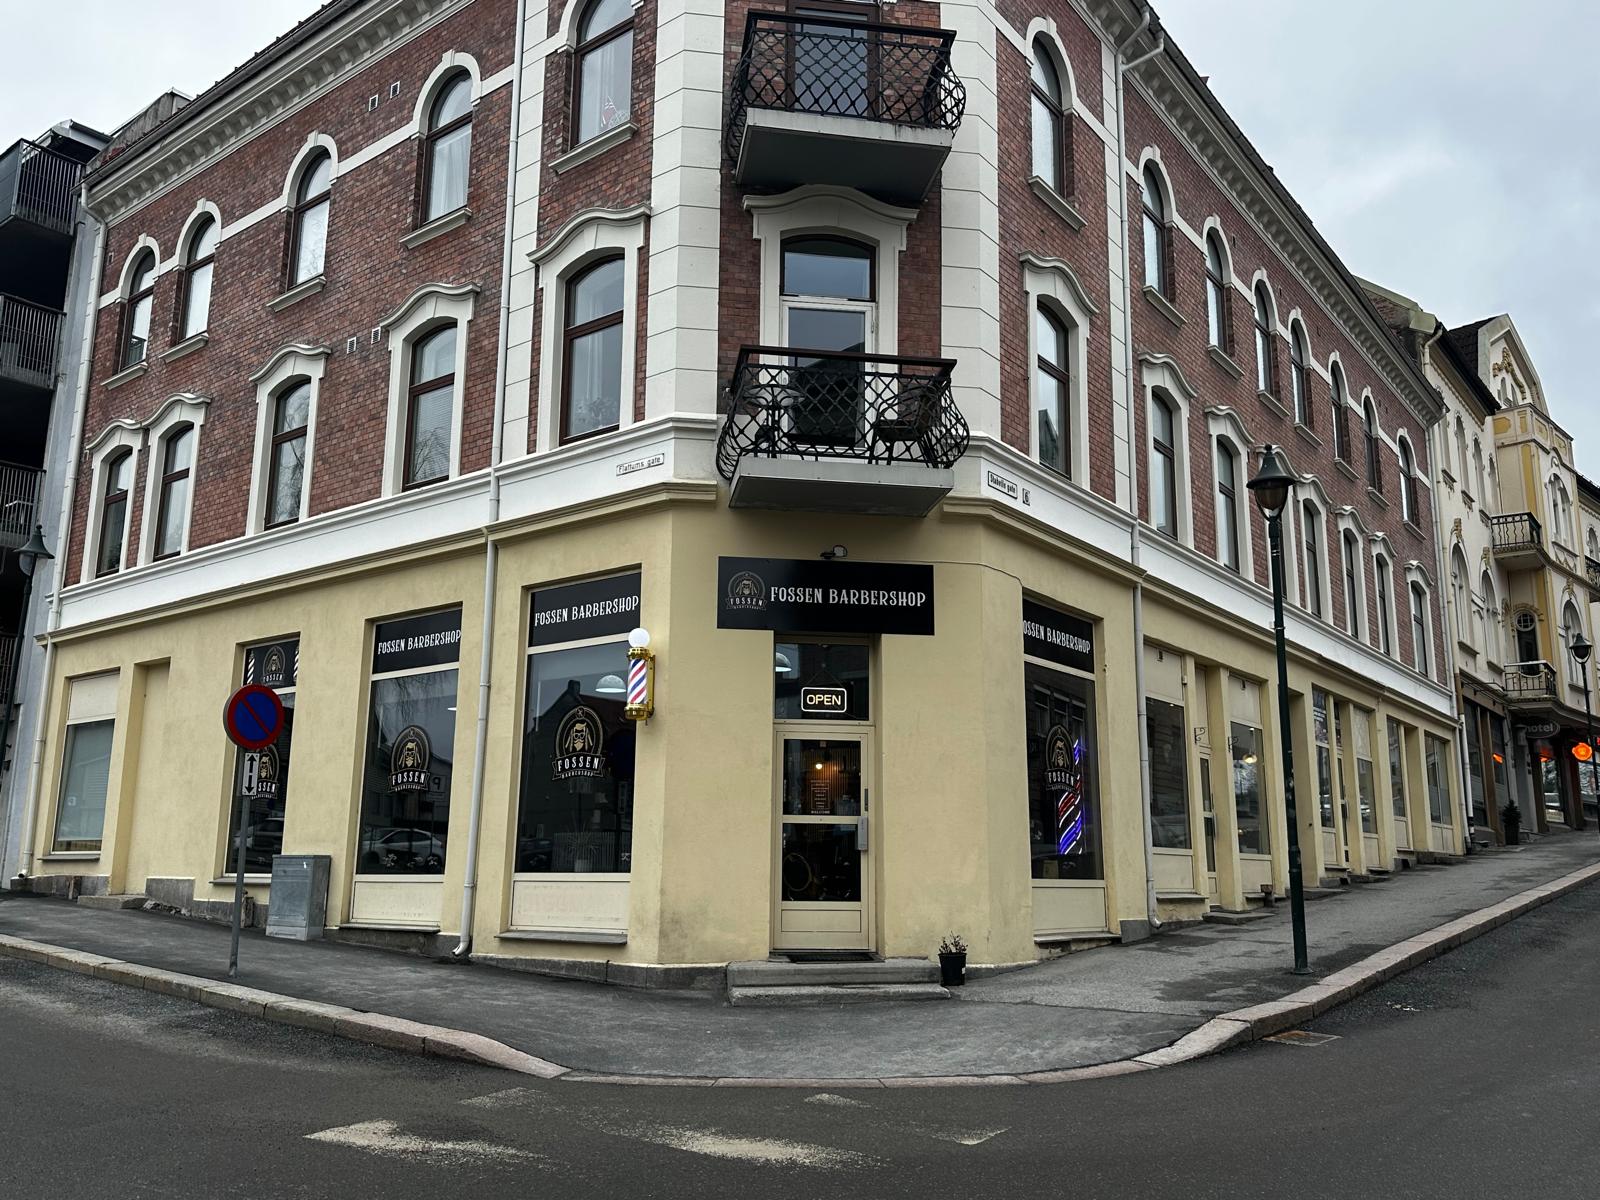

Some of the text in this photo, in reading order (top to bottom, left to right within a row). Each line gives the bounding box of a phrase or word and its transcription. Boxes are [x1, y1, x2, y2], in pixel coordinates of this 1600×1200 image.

[646, 456, 661, 467] gate
[730, 597, 763, 606] FOSSEN
[770, 586, 926, 607] FOSSEN BARBERSHOP
[534, 595, 639, 627] FOSSEN BARBERSHOP
[377, 629, 462, 655] FOSSEN BARBERSHOP
[1023, 620, 1091, 654] OSSEN BARBERSHOP
[806, 694, 842, 706] OPEN
[557, 755, 600, 772] FOSSEN
[392, 771, 426, 786] FOSSEN
[1048, 771, 1074, 787] FOSSEN
[257, 782, 276, 793] SSEN
